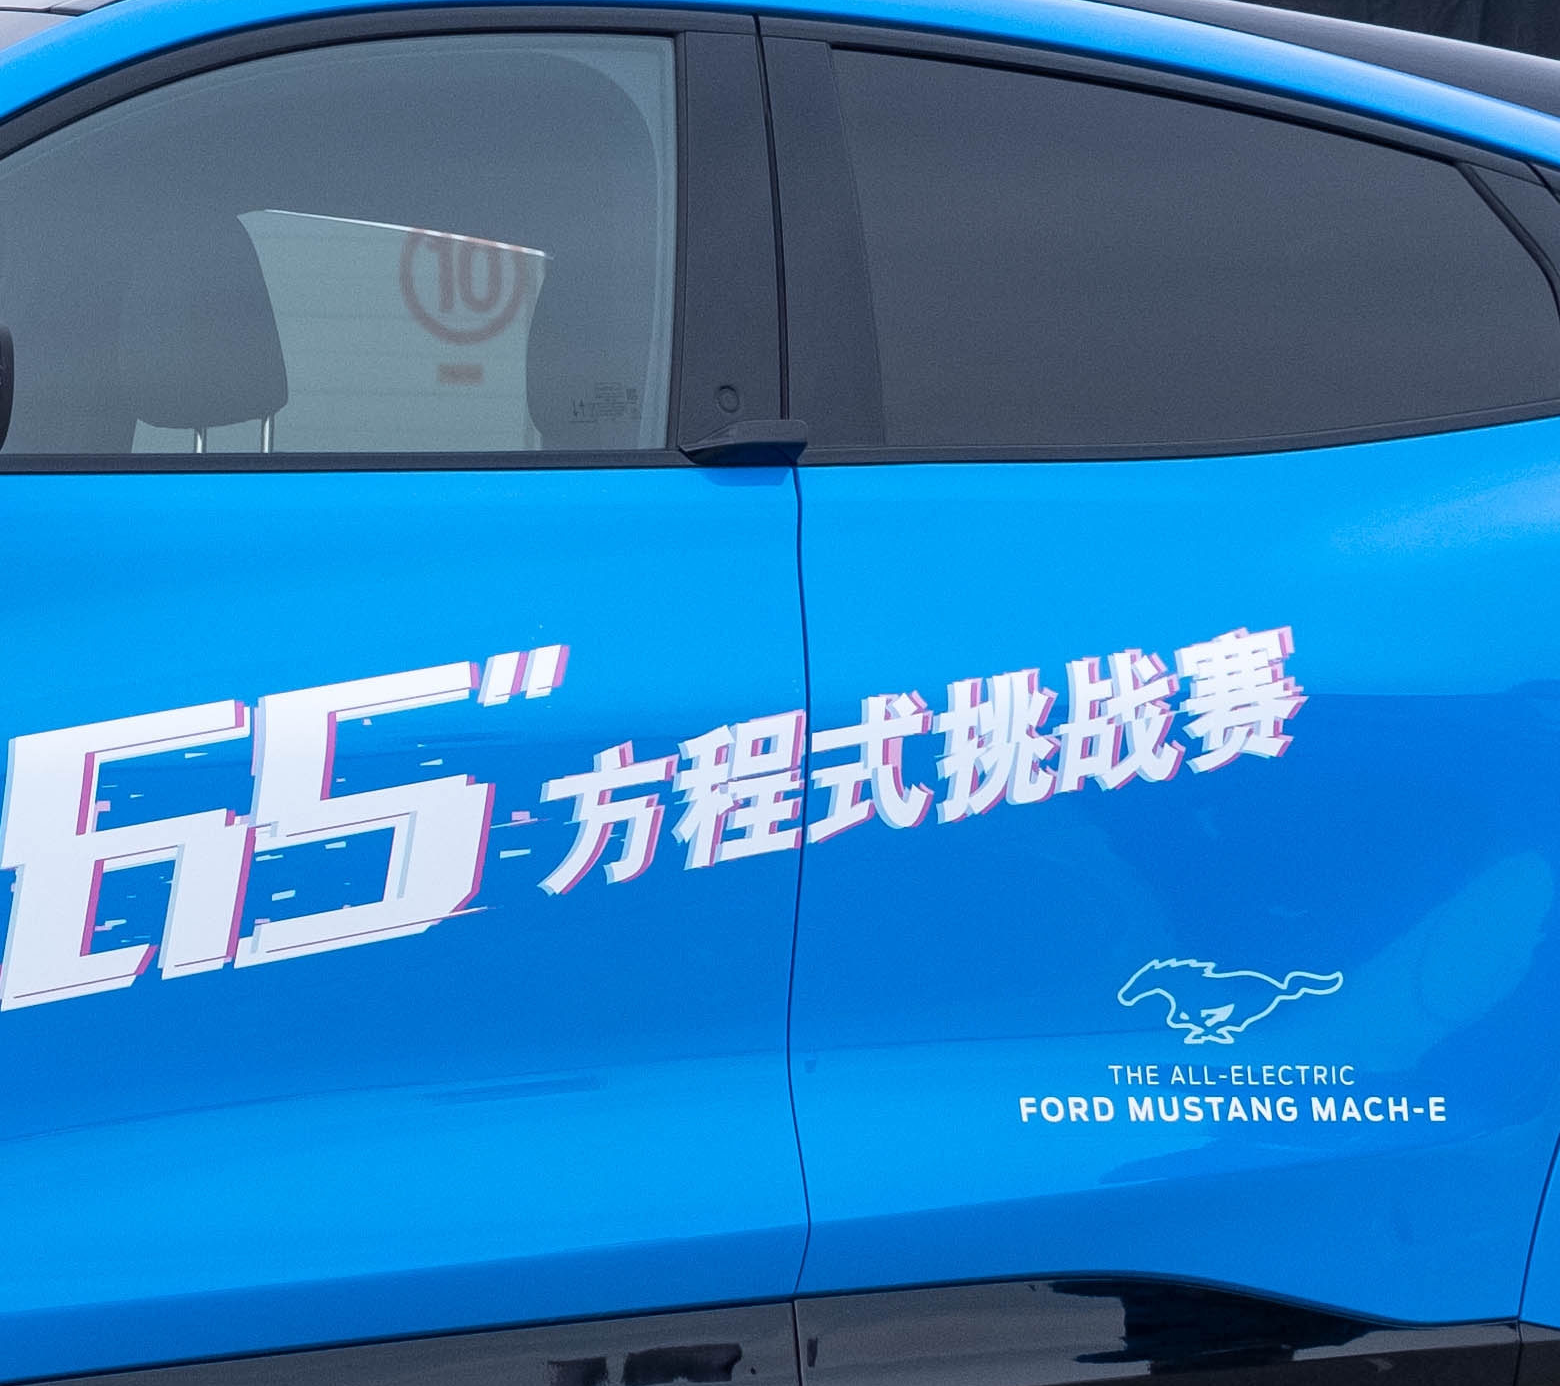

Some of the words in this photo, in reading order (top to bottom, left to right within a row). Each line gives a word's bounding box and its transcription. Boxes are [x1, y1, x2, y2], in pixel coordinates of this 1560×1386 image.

[425, 239, 502, 314] 10
[537, 625, 1308, 895] 方程式挑战赛
[1108, 1064, 1160, 1086] THE
[1170, 1064, 1356, 1086] ALL-ELECTRIC
[1018, 1095, 1115, 1124] FORD
[1128, 1095, 1299, 1124] MUSTANG
[1311, 1095, 1447, 1123] MACH-E
